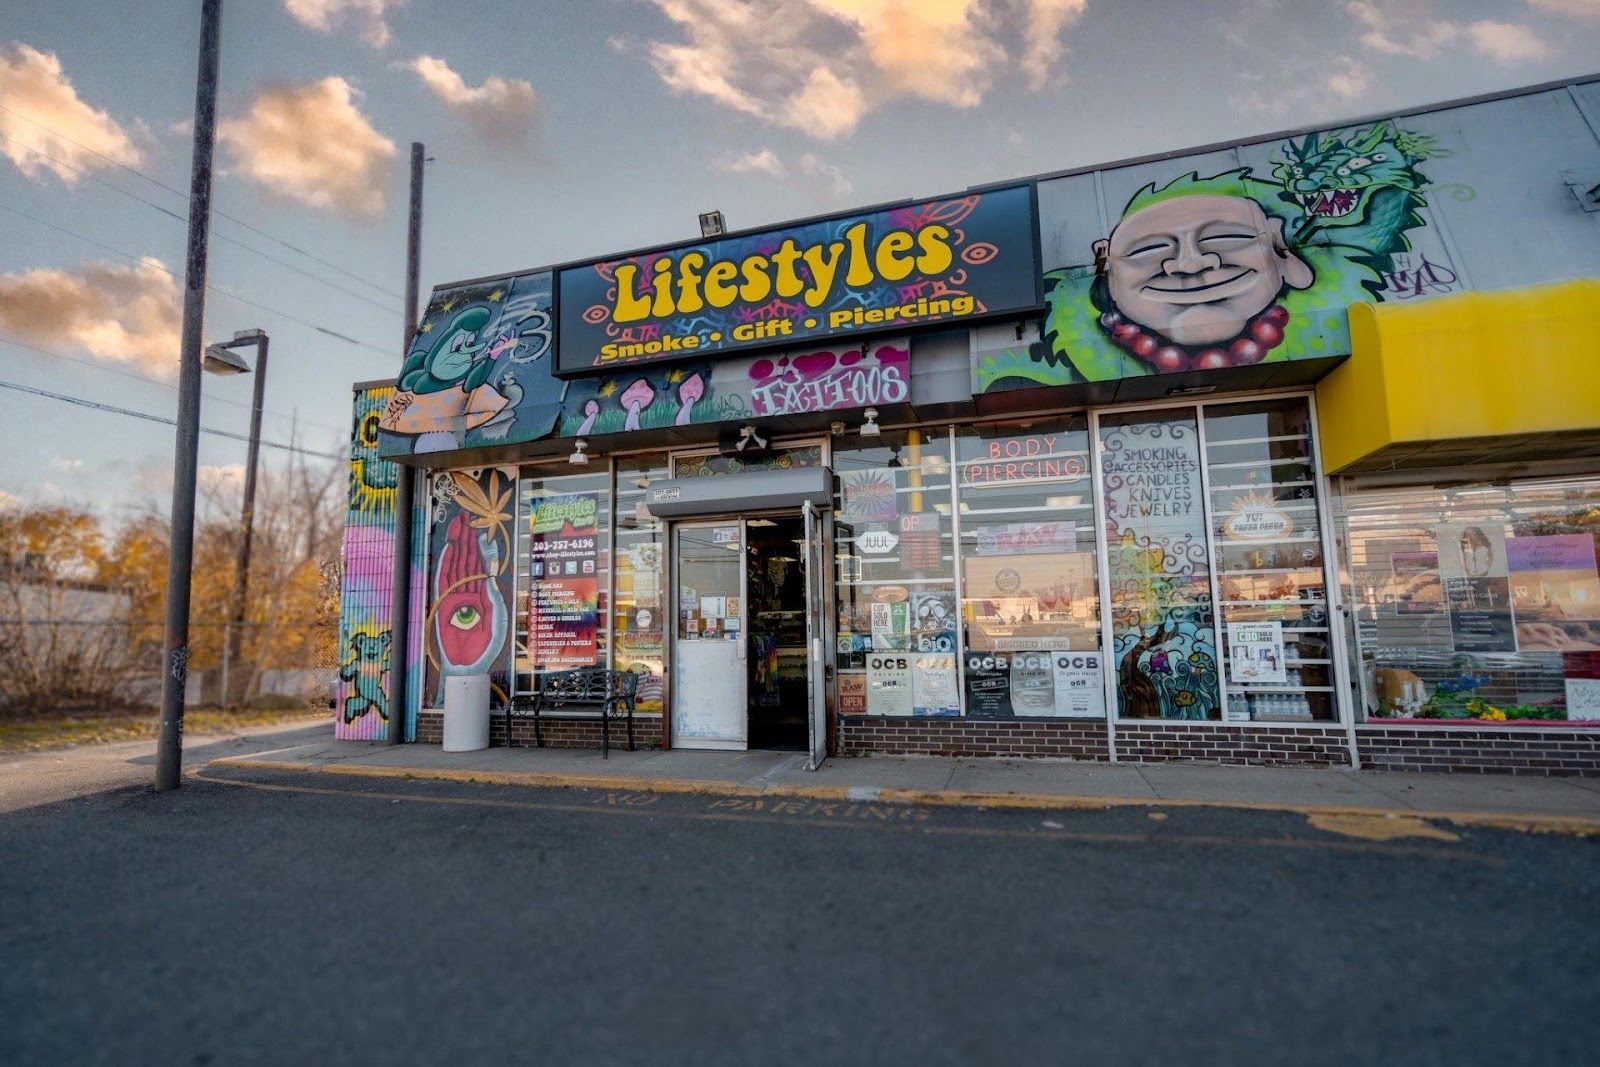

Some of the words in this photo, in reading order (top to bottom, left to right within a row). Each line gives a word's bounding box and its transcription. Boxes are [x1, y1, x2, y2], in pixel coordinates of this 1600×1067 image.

[612, 222, 954, 324] Lifestyles
[600, 335, 700, 361] Smoke
[733, 318, 793, 343] Gift
[830, 295, 974, 329] Piercing
[751, 366, 907, 416] TATTOOS
[989, 437, 1056, 459] BODY
[1124, 446, 1187, 461] SMOKING
[971, 458, 1080, 482] PIERCING
[1114, 461, 1197, 473] ACCESSORIES
[1126, 473, 1190, 487] CANDLES
[1129, 487, 1191, 502] KNIVES
[1119, 502, 1192, 518] JEWELRY
[533, 538, 594, 551] 203-757-6196
[864, 535, 889, 548] JUUL
[873, 611, 888, 619] SOLD
[1239, 631, 1259, 642] CBD
[871, 658, 908, 670] OCB
[968, 657, 1008, 670] OCB
[1012, 657, 1052, 670] OCB
[1057, 657, 1098, 669] OCB
[843, 696, 863, 707] OPEN
[708, 797, 930, 822] PARKING
